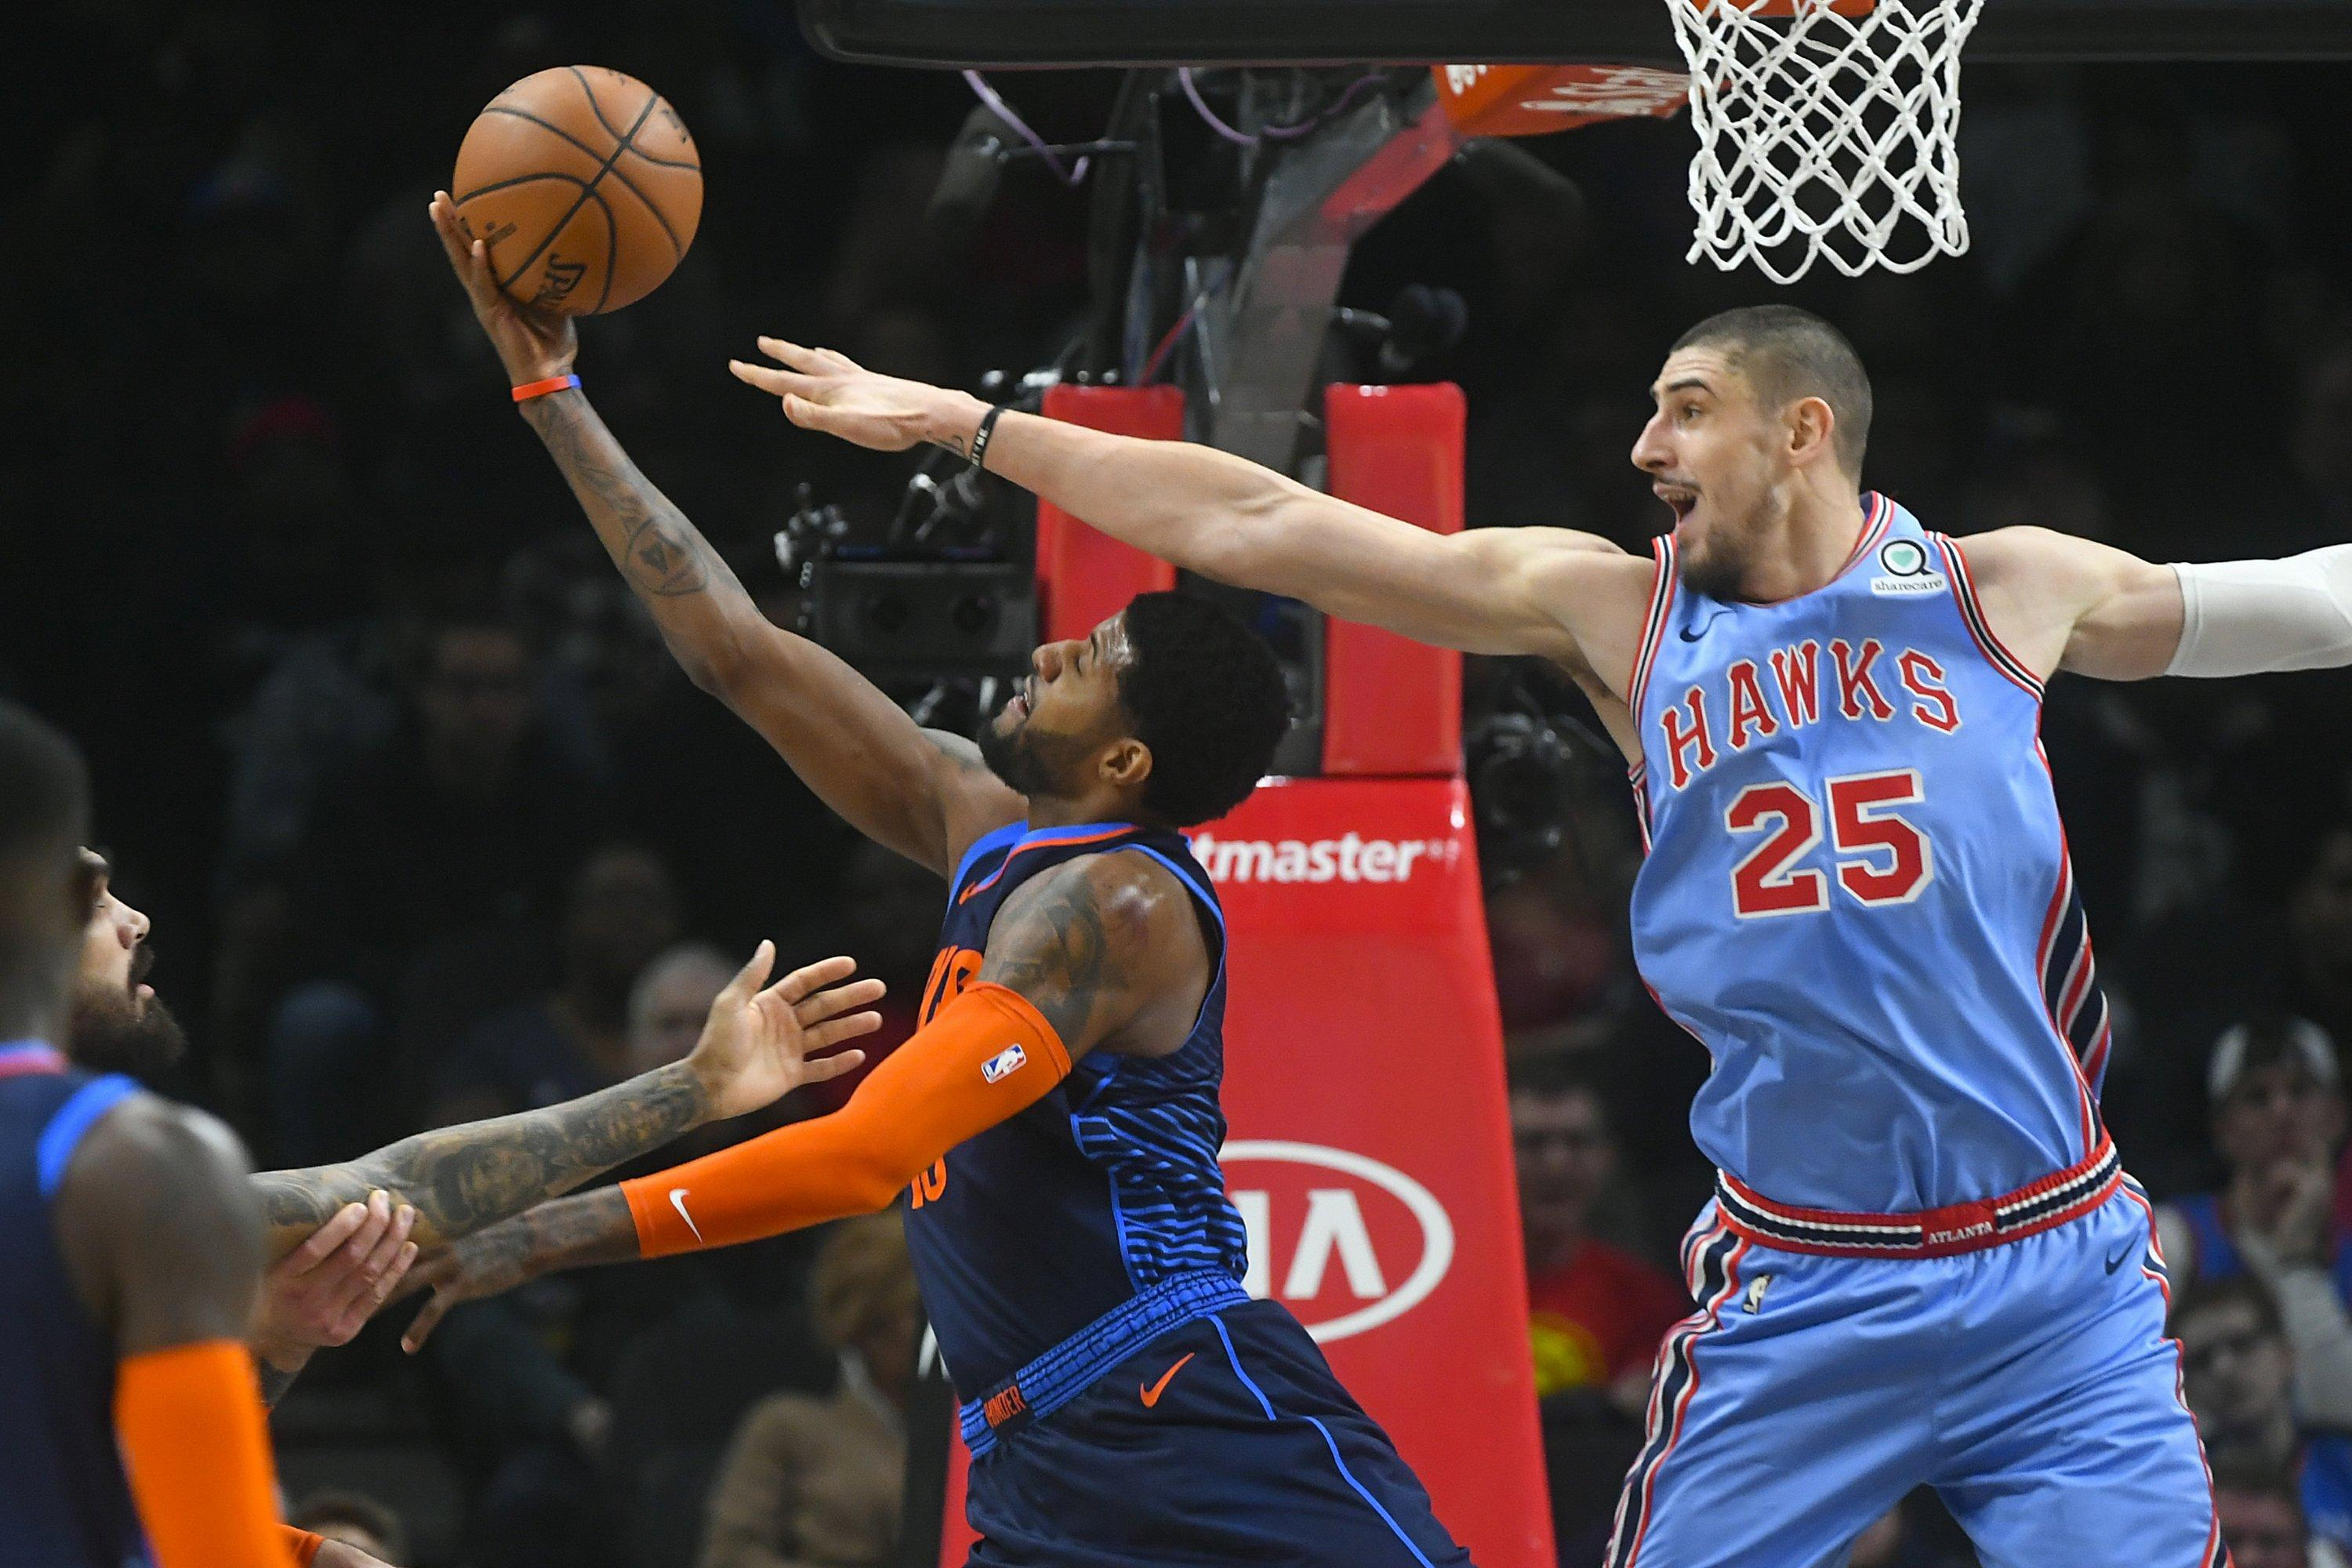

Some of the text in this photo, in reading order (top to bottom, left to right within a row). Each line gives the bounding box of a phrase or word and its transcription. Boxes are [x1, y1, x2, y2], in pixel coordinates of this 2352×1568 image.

[1874, 578, 1944, 592] sharecare
[1660, 637, 1962, 792] HAWKS
[1190, 832, 1427, 883] tmaster
[1725, 768, 1935, 920] 25
[1230, 1188, 1388, 1301] IA
[1928, 1221, 1994, 1245] ATLANTA
